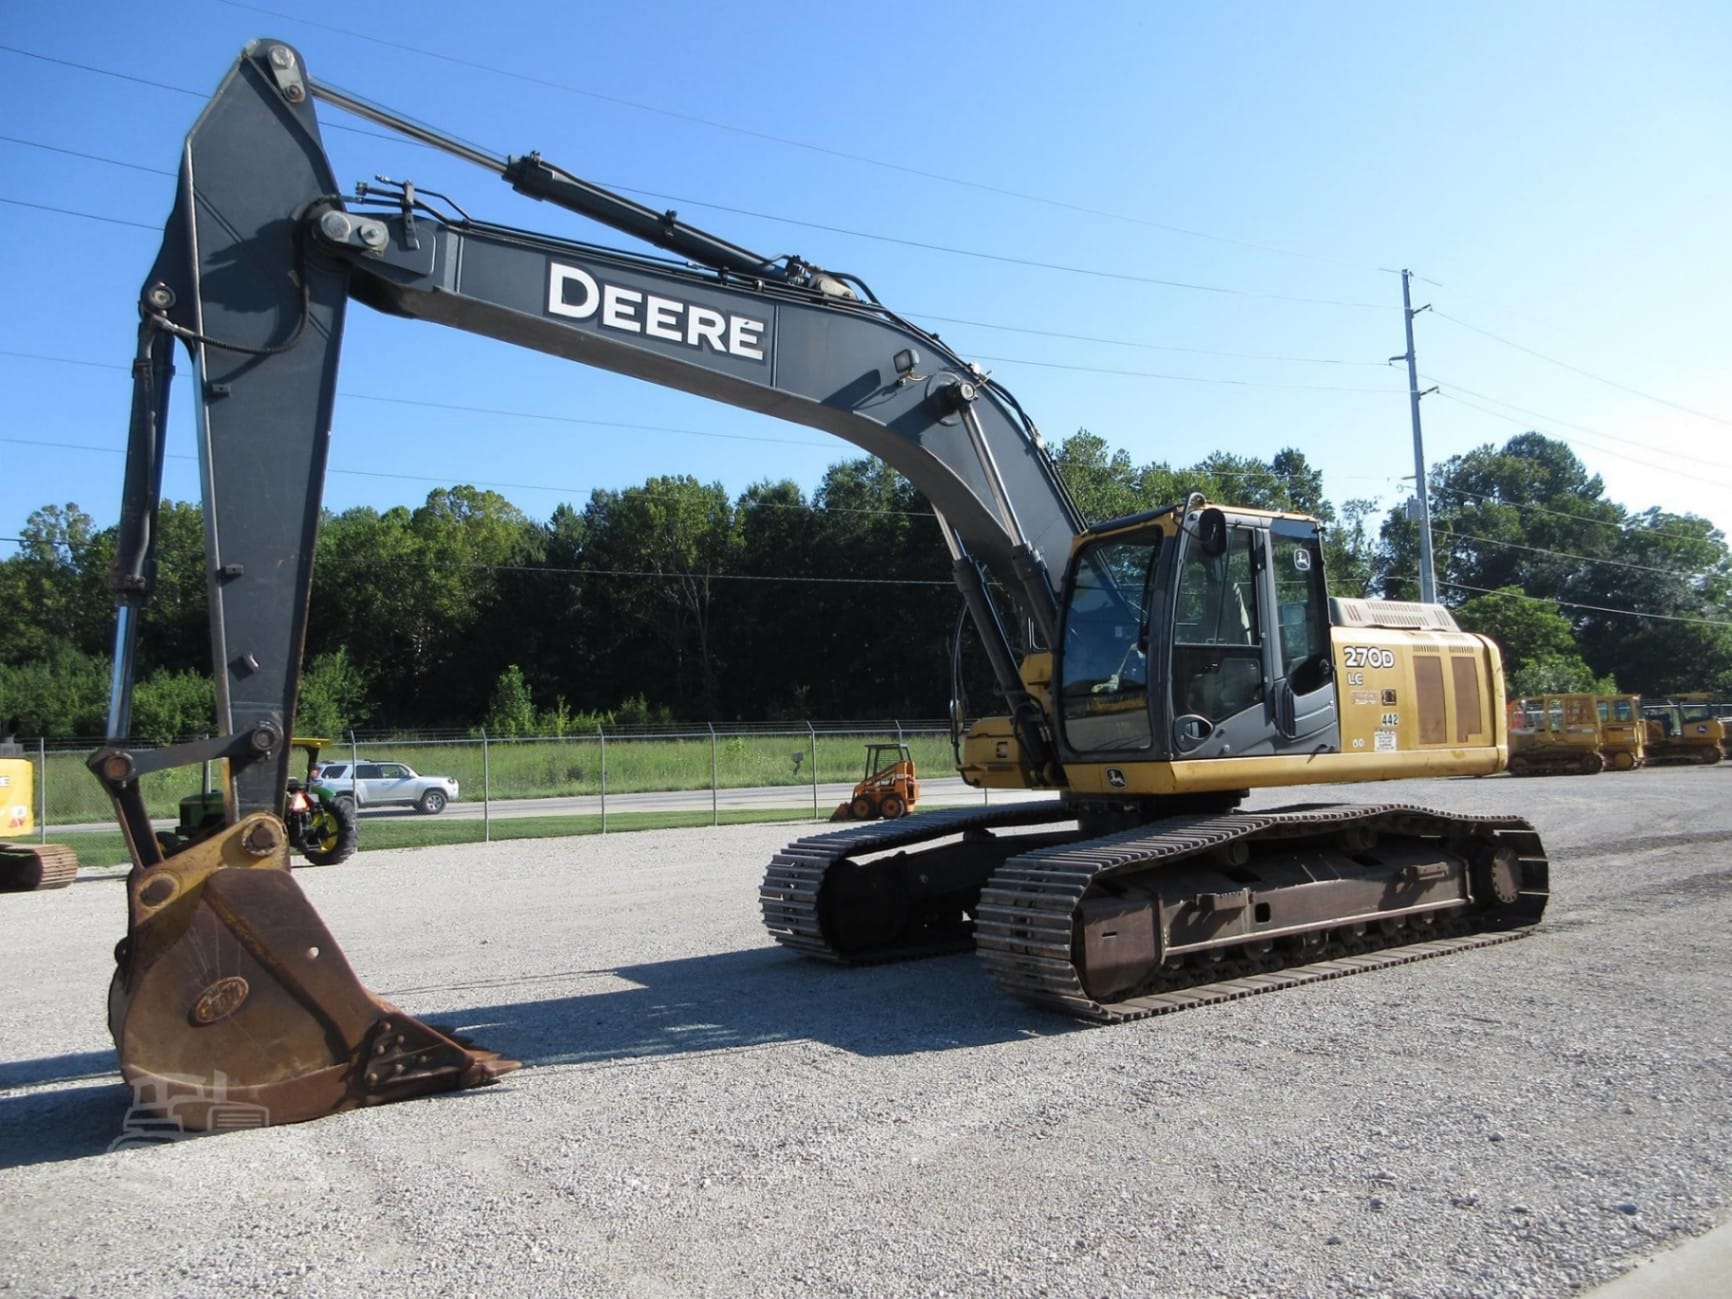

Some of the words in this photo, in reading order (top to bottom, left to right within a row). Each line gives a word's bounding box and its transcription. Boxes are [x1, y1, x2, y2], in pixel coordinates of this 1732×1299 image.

[548, 261, 765, 361] DEERE
[1343, 646, 1395, 669] 270D
[1347, 672, 1364, 686] LC
[1381, 713, 1399, 727] 442
